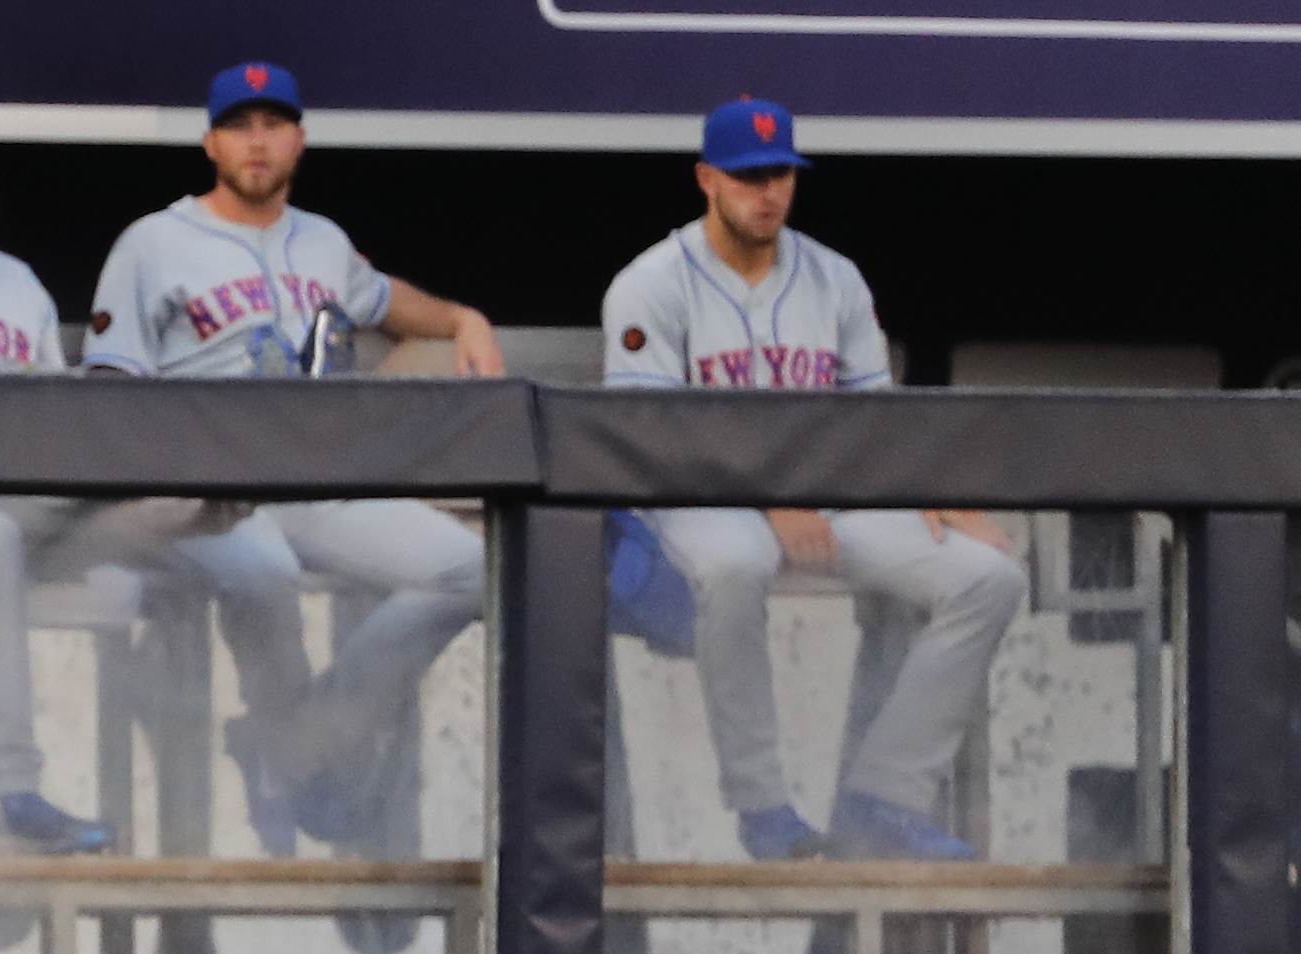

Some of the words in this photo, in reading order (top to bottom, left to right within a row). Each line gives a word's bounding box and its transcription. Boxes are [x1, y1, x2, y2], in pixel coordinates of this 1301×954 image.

[185, 275, 275, 341] NEW
[686, 349, 754, 388] EW
[759, 344, 841, 388] YOR
